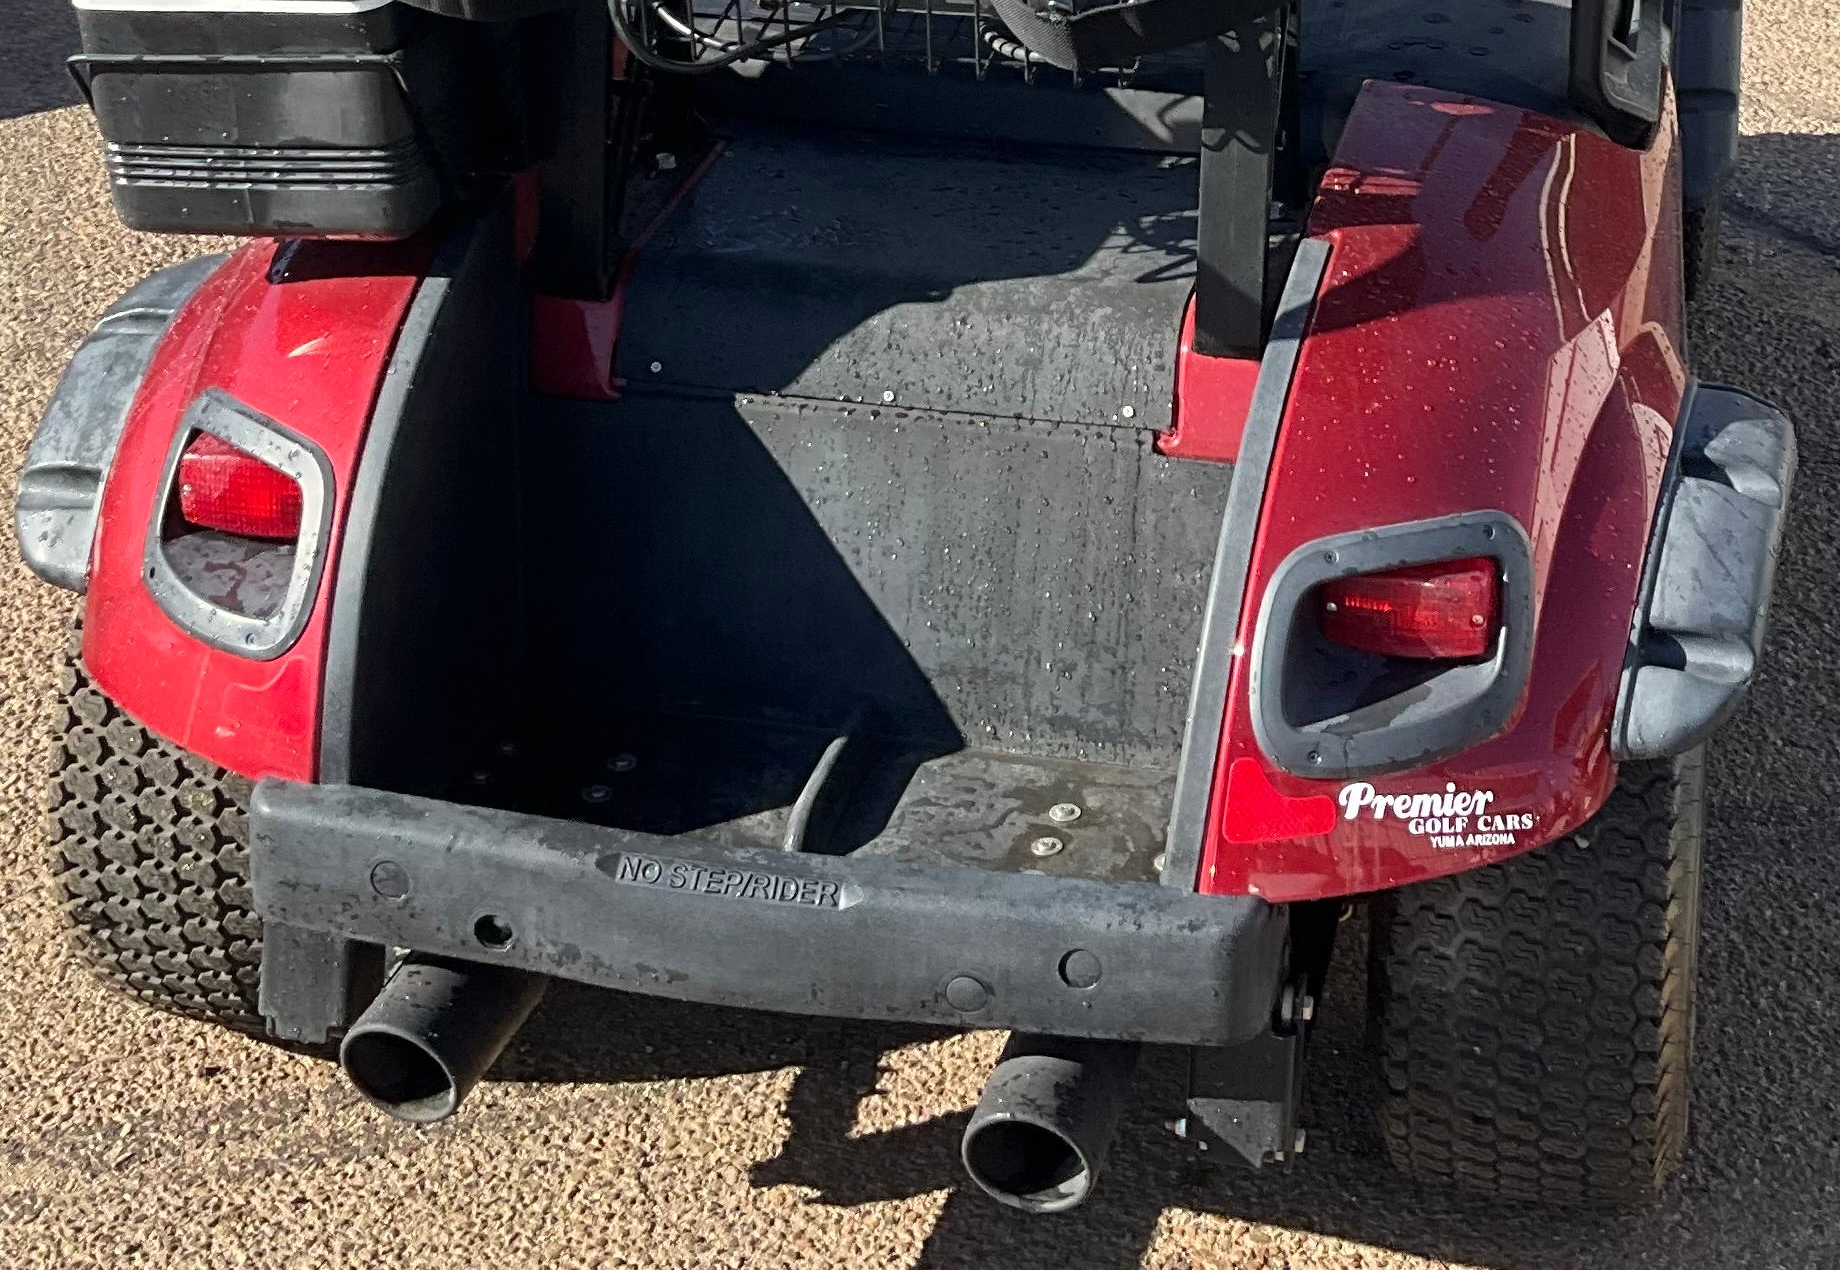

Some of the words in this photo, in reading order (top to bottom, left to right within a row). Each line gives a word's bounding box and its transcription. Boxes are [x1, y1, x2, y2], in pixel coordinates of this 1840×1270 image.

[1338, 781, 1494, 820] Premier
[1408, 816, 1468, 835] GOLF
[1477, 813, 1534, 832] CARS
[1430, 834, 1465, 849] YUMA
[1466, 832, 1516, 847] ARIZONA
[619, 856, 663, 885] NO
[669, 863, 839, 908] STEP/RIDER
